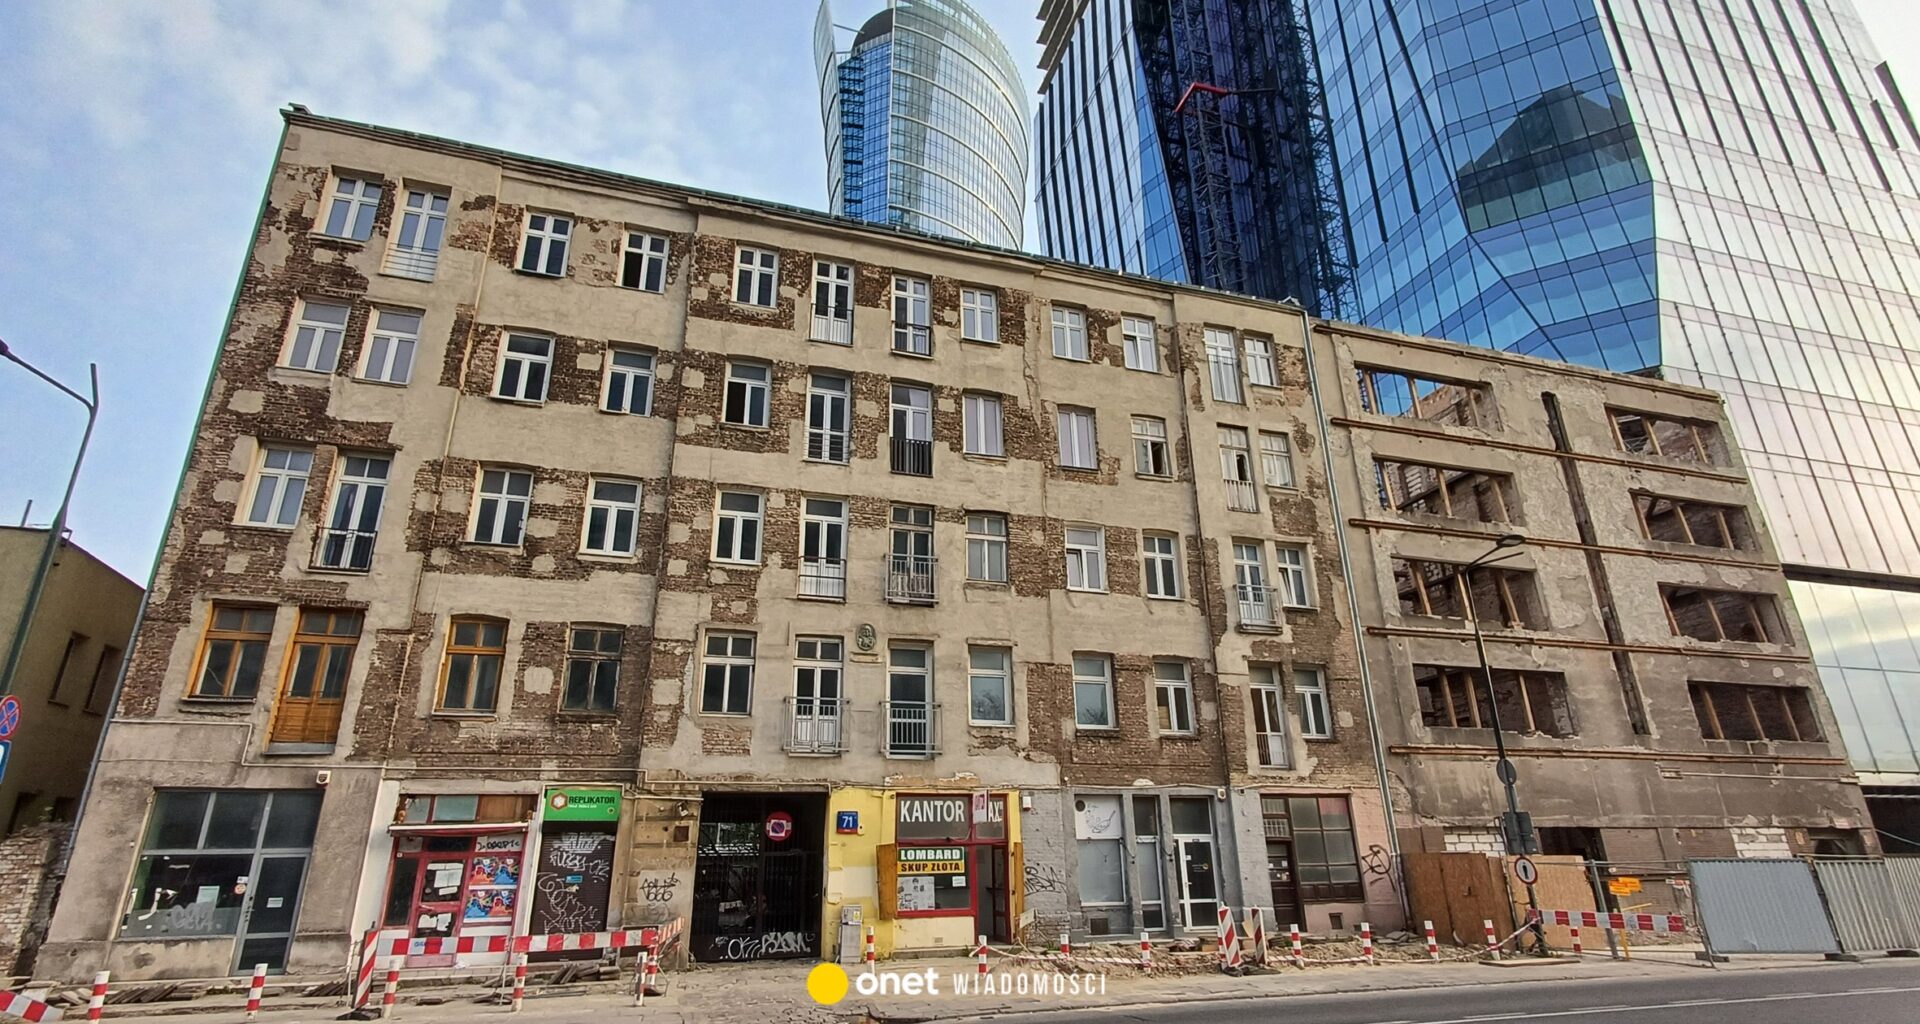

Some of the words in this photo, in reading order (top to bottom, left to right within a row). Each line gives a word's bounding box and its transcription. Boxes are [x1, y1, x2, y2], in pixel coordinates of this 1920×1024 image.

[569, 795, 615, 805] REPLIKATOR
[900, 800, 965, 823] KANTOR
[842, 815, 853, 828] 71
[900, 849, 961, 861] LOMBARD
[900, 863, 928, 872] SKUP
